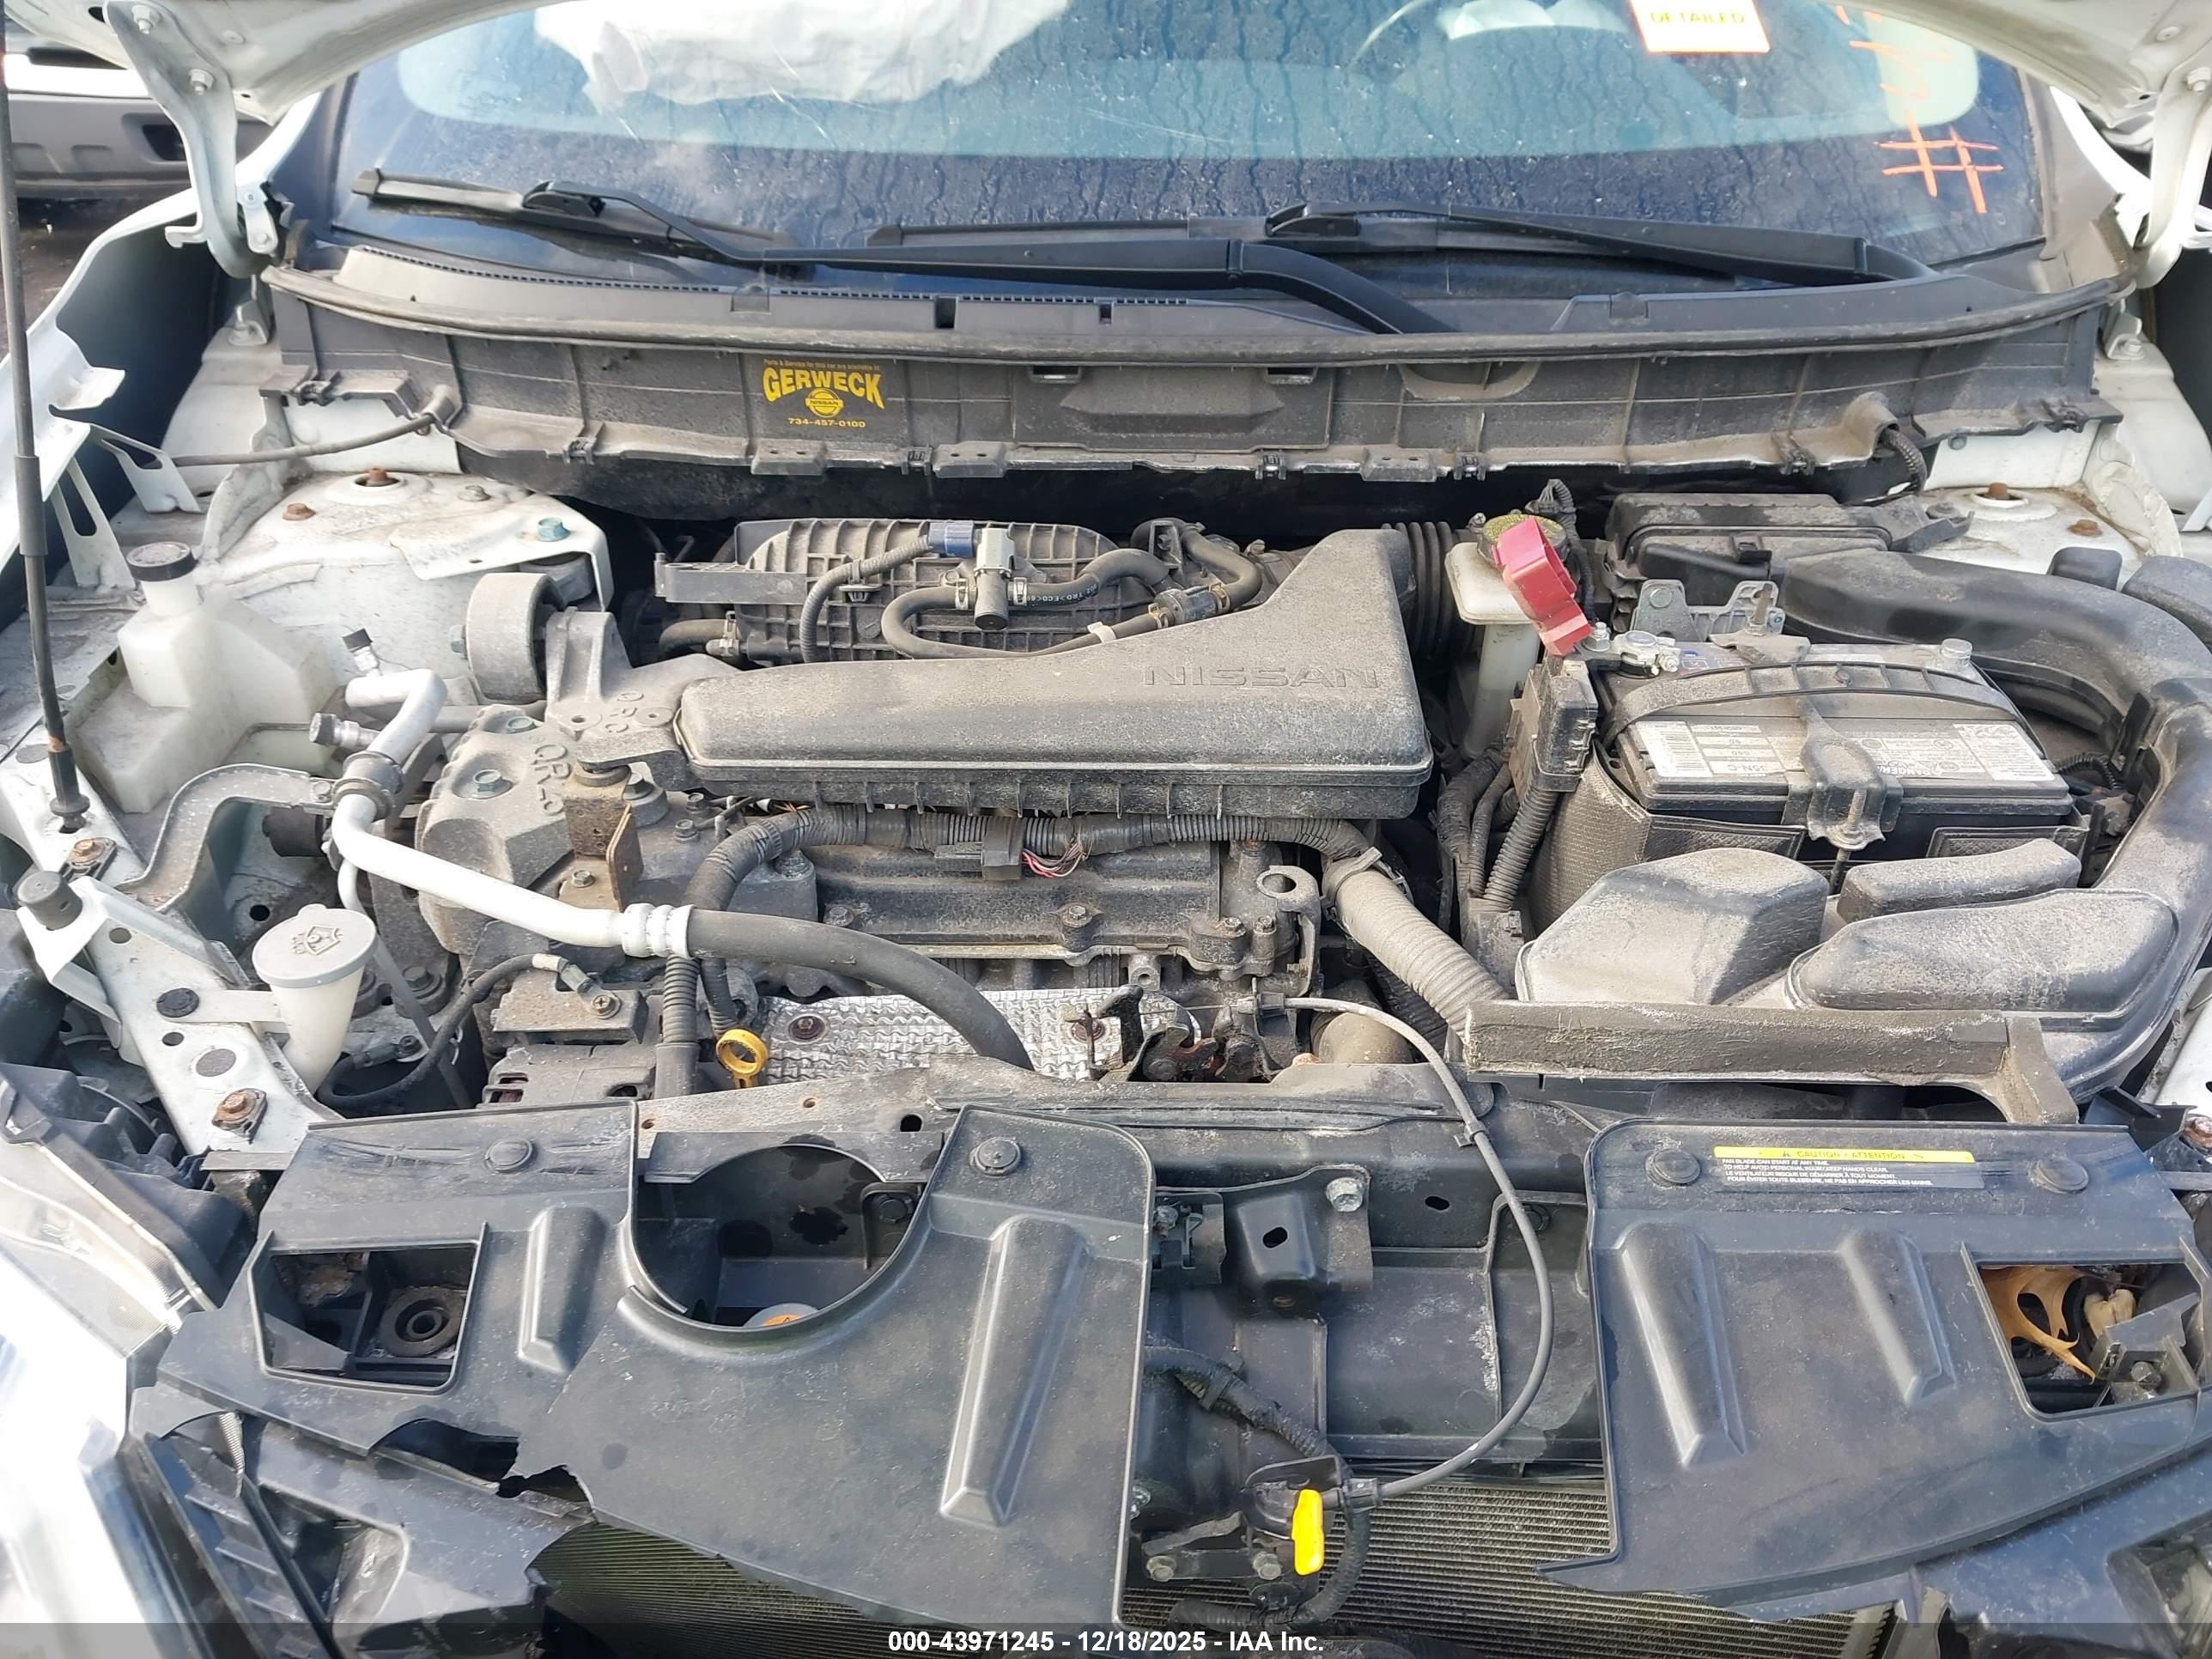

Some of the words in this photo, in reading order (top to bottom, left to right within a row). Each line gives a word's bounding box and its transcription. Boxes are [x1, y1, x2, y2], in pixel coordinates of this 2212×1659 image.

[763, 367, 885, 410] GERWECK
[787, 418, 866, 428] 734-457-0100
[1144, 665, 1380, 688] NISSAN
